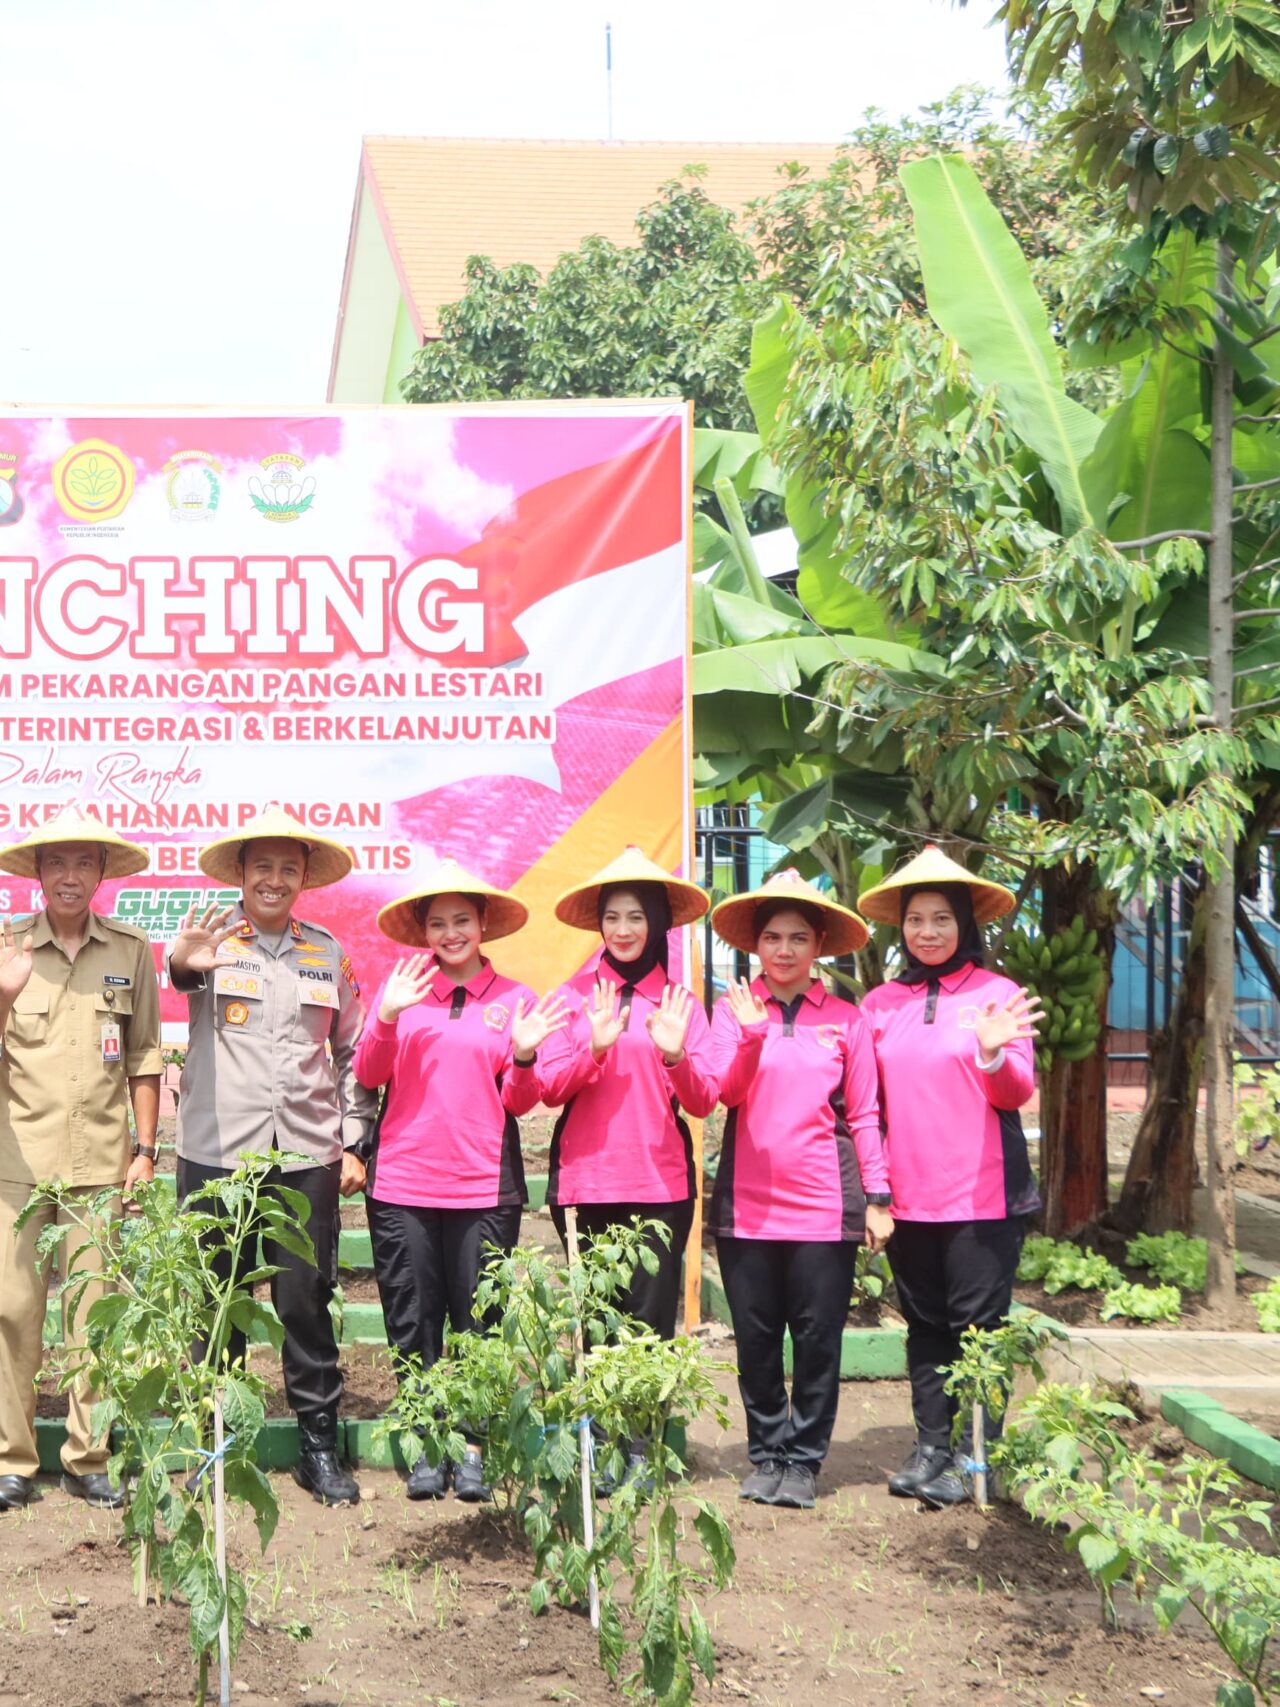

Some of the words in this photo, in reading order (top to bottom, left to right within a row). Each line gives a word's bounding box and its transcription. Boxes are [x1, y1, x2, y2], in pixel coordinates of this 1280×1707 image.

[21, 673, 253, 698] PEKARANGAN
[263, 673, 407, 697] PANGAN
[414, 673, 542, 697] LESTARI
[243, 716, 264, 741] &
[273, 716, 553, 741] BERKELANJUTAN
[96, 746, 202, 808] Rangka
[18, 803, 228, 828] KEAHANAN
[237, 802, 381, 828] PNGAN
[117, 890, 240, 916] GUGUS
[298, 969, 333, 983] POLRI
